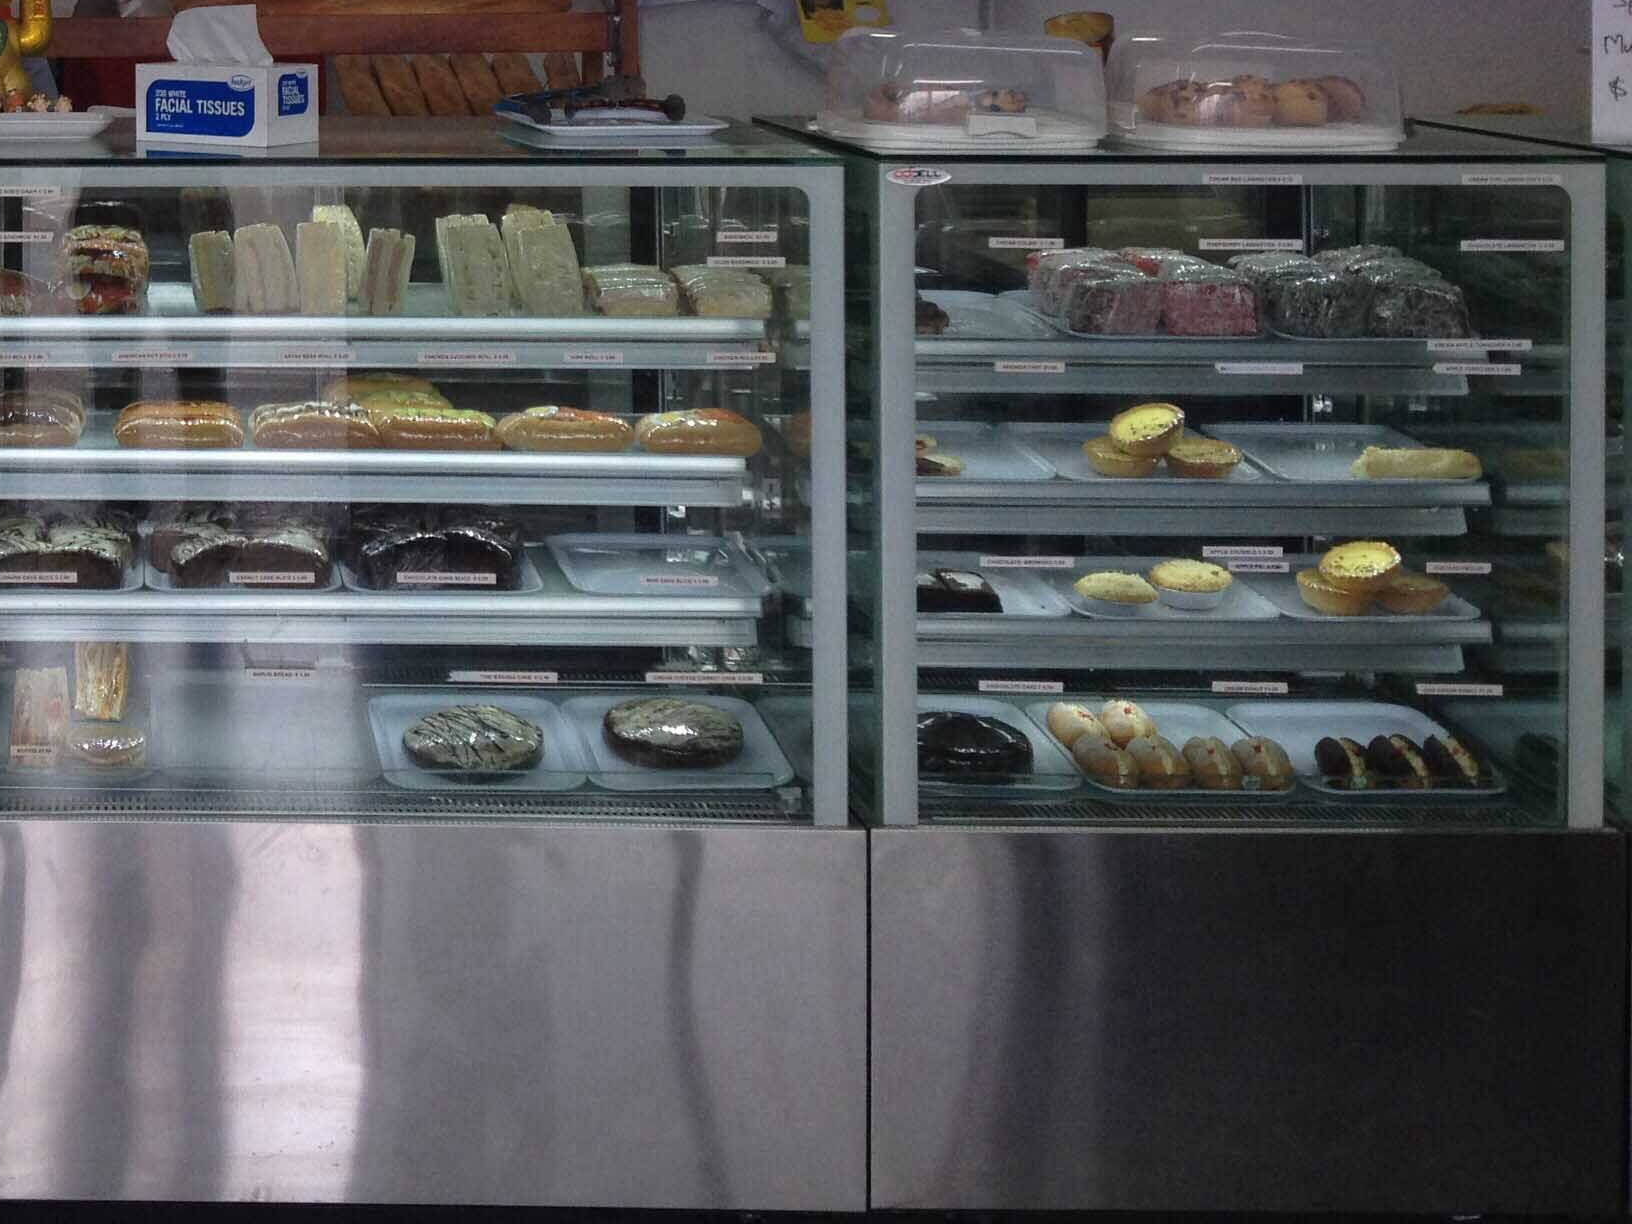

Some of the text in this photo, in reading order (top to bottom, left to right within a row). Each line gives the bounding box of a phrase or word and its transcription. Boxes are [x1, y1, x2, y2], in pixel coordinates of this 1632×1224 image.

[168, 89, 188, 99] WHITE
[282, 86, 300, 96] FACIAL
[282, 95, 305, 105] TISSUES
[154, 98, 246, 117] FACIAL TISSUES
